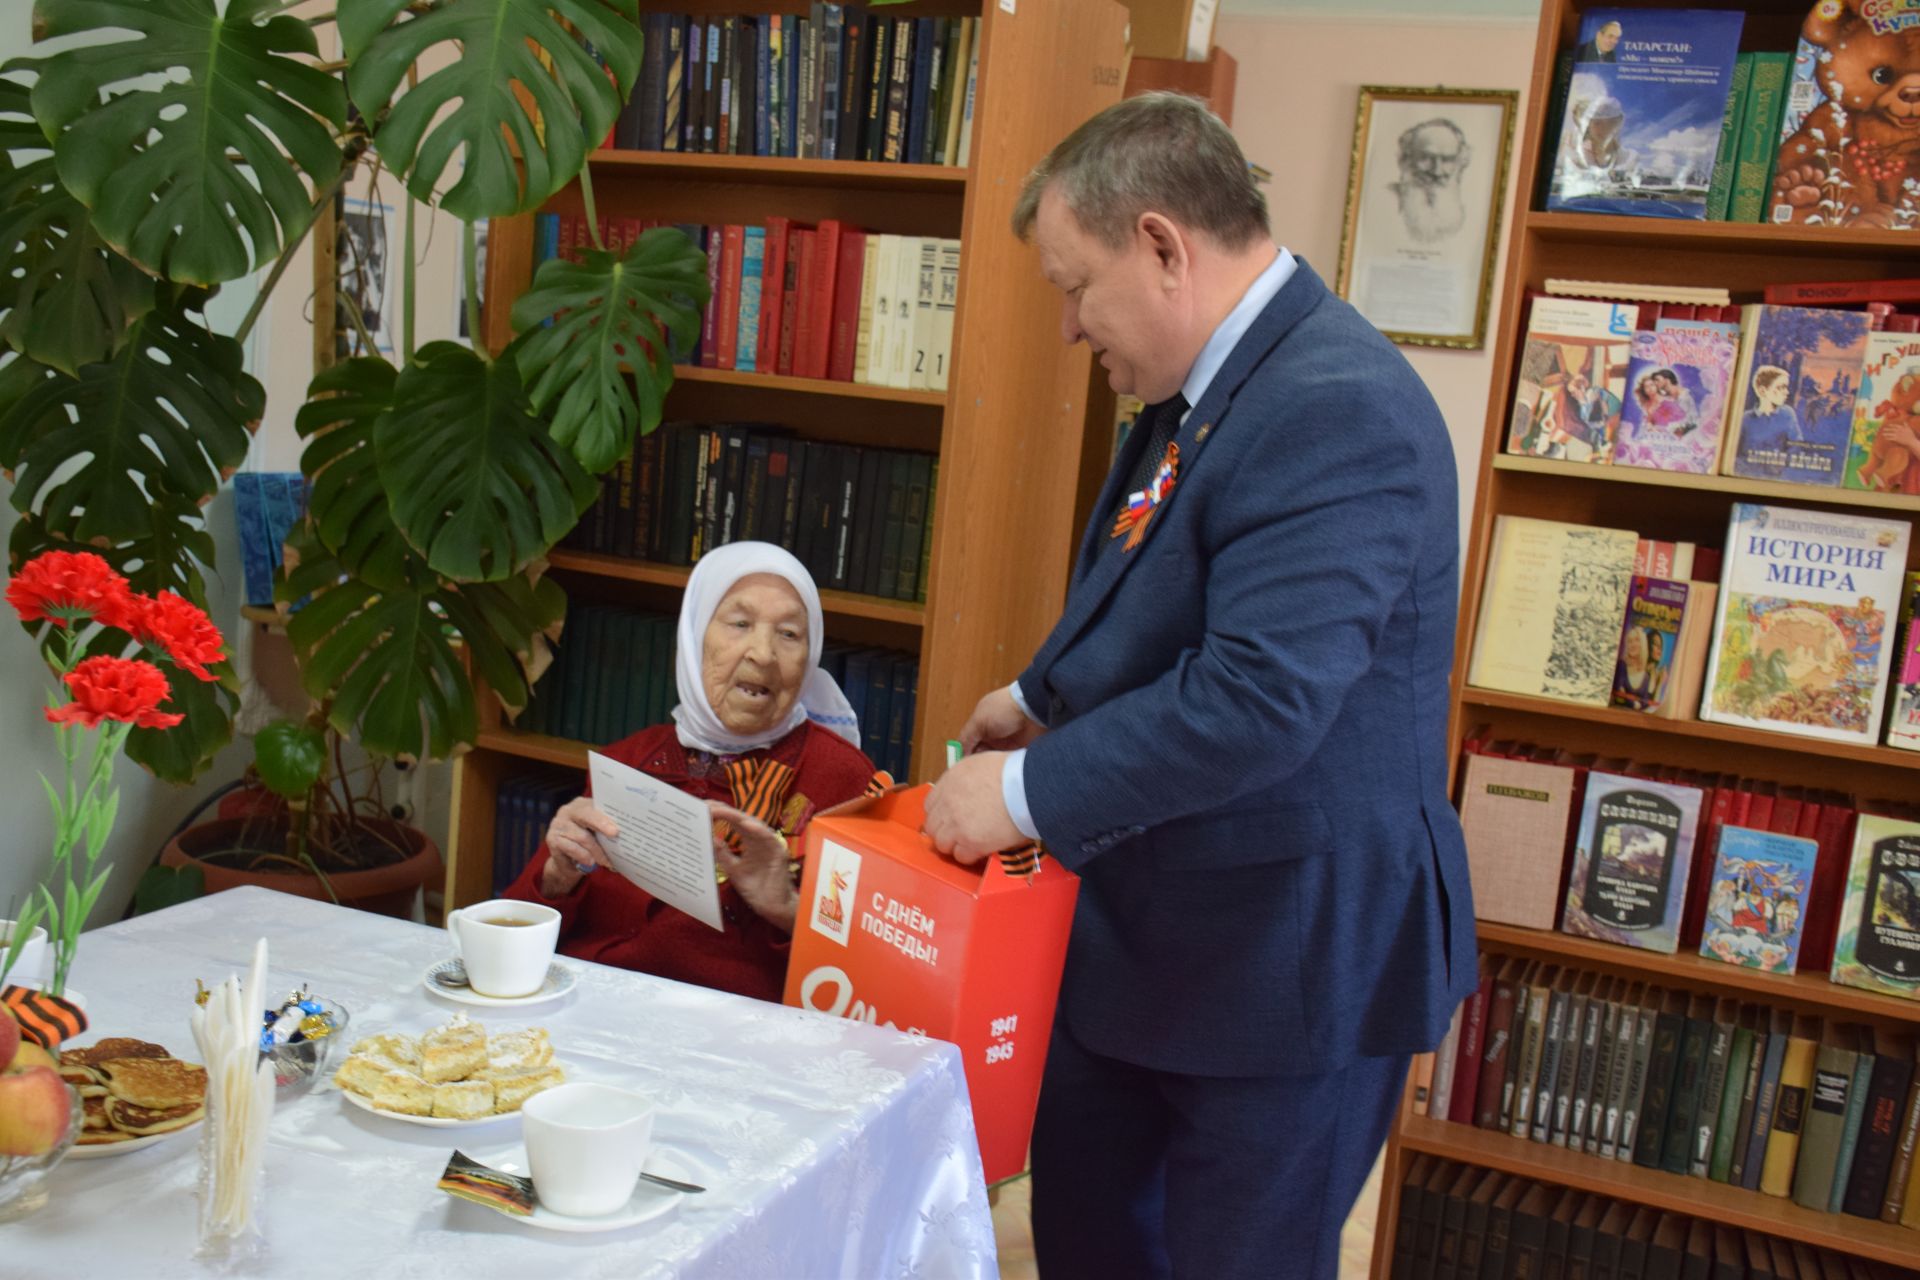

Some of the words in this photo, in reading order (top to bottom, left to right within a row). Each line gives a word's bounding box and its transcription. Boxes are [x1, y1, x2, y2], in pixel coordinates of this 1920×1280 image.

[1624, 41, 1693, 53] ТАТАРСТАН:
[914, 349, 925, 373] 2
[936, 354, 943, 375] 1
[1867, 343, 1920, 376] ИГРУШ
[1748, 535, 1886, 570] ИСТОРИЯ
[1766, 563, 1856, 592] МИРА
[872, 892, 884, 911] С
[884, 898, 935, 938] ДНЁМ
[860, 911, 938, 967] ПОБЕДЫ!
[990, 1014, 1018, 1037] 1941
[985, 1041, 1014, 1064] 1945
